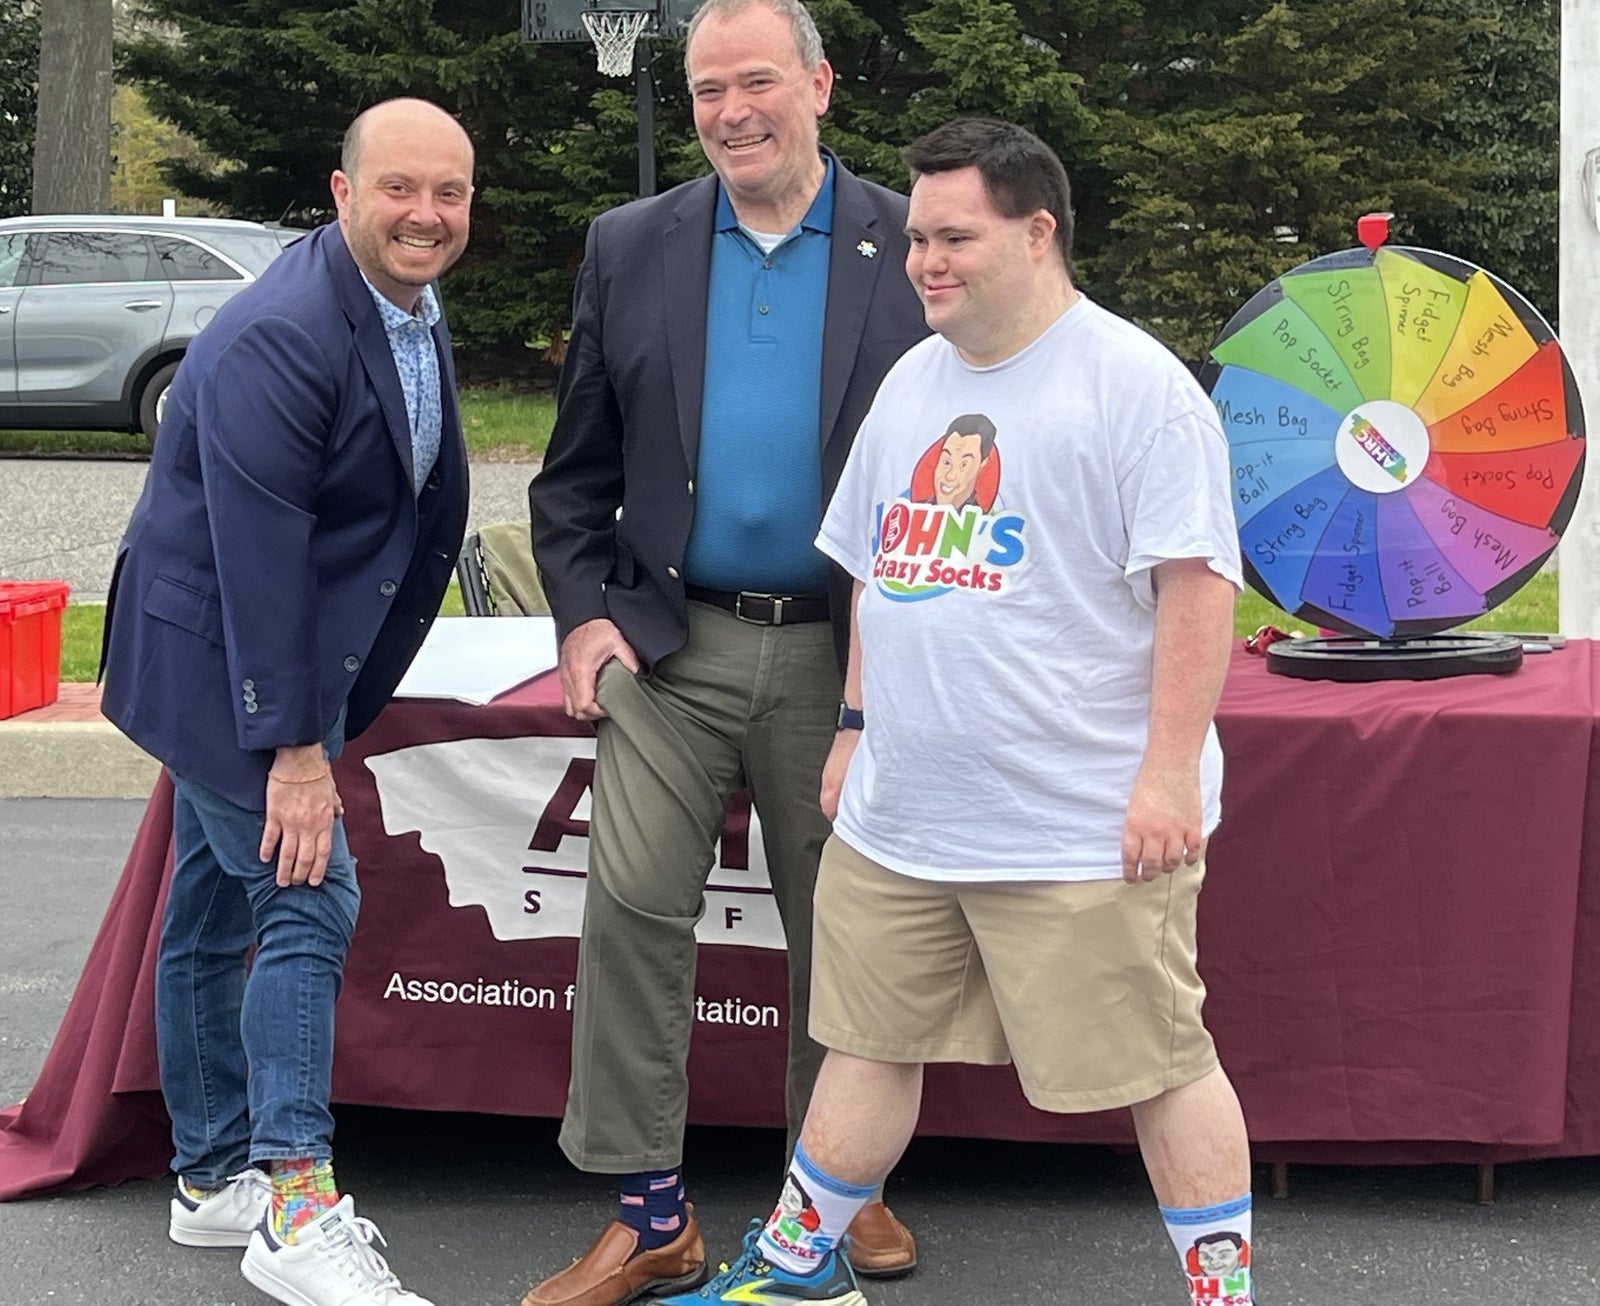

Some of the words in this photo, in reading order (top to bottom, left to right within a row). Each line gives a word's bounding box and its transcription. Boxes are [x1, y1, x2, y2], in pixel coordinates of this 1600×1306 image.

[1327, 280, 1354, 338] String
[1351, 336, 1370, 370] Bag
[1413, 289, 1451, 343] Fidget
[1471, 314, 1514, 356] Mesh
[1272, 318, 1297, 350] Pop
[1298, 347, 1343, 392] Socket
[1441, 364, 1475, 388] Bag
[1216, 399, 1265, 425] Mesh
[1278, 406, 1308, 436] Bag
[1461, 415, 1497, 437] Bag
[1498, 398, 1554, 423] String
[1235, 451, 1274, 480] op-it
[1354, 428, 1397, 468] AHRC
[1239, 476, 1270, 505] Ball
[1462, 470, 1517, 490] Socket
[1526, 463, 1554, 489] Pop
[872, 502, 1026, 567] JOHN'S
[1255, 523, 1306, 565] String
[1294, 497, 1328, 520] Bag
[1441, 499, 1467, 536] Bag
[1474, 527, 1518, 571] Mesh
[873, 557, 921, 585] Crazy
[925, 559, 1003, 592] Socks
[1328, 564, 1364, 612] Fidget
[1424, 561, 1452, 596] Ball
[383, 972, 555, 1010] Association
[695, 996, 779, 1027] tation
